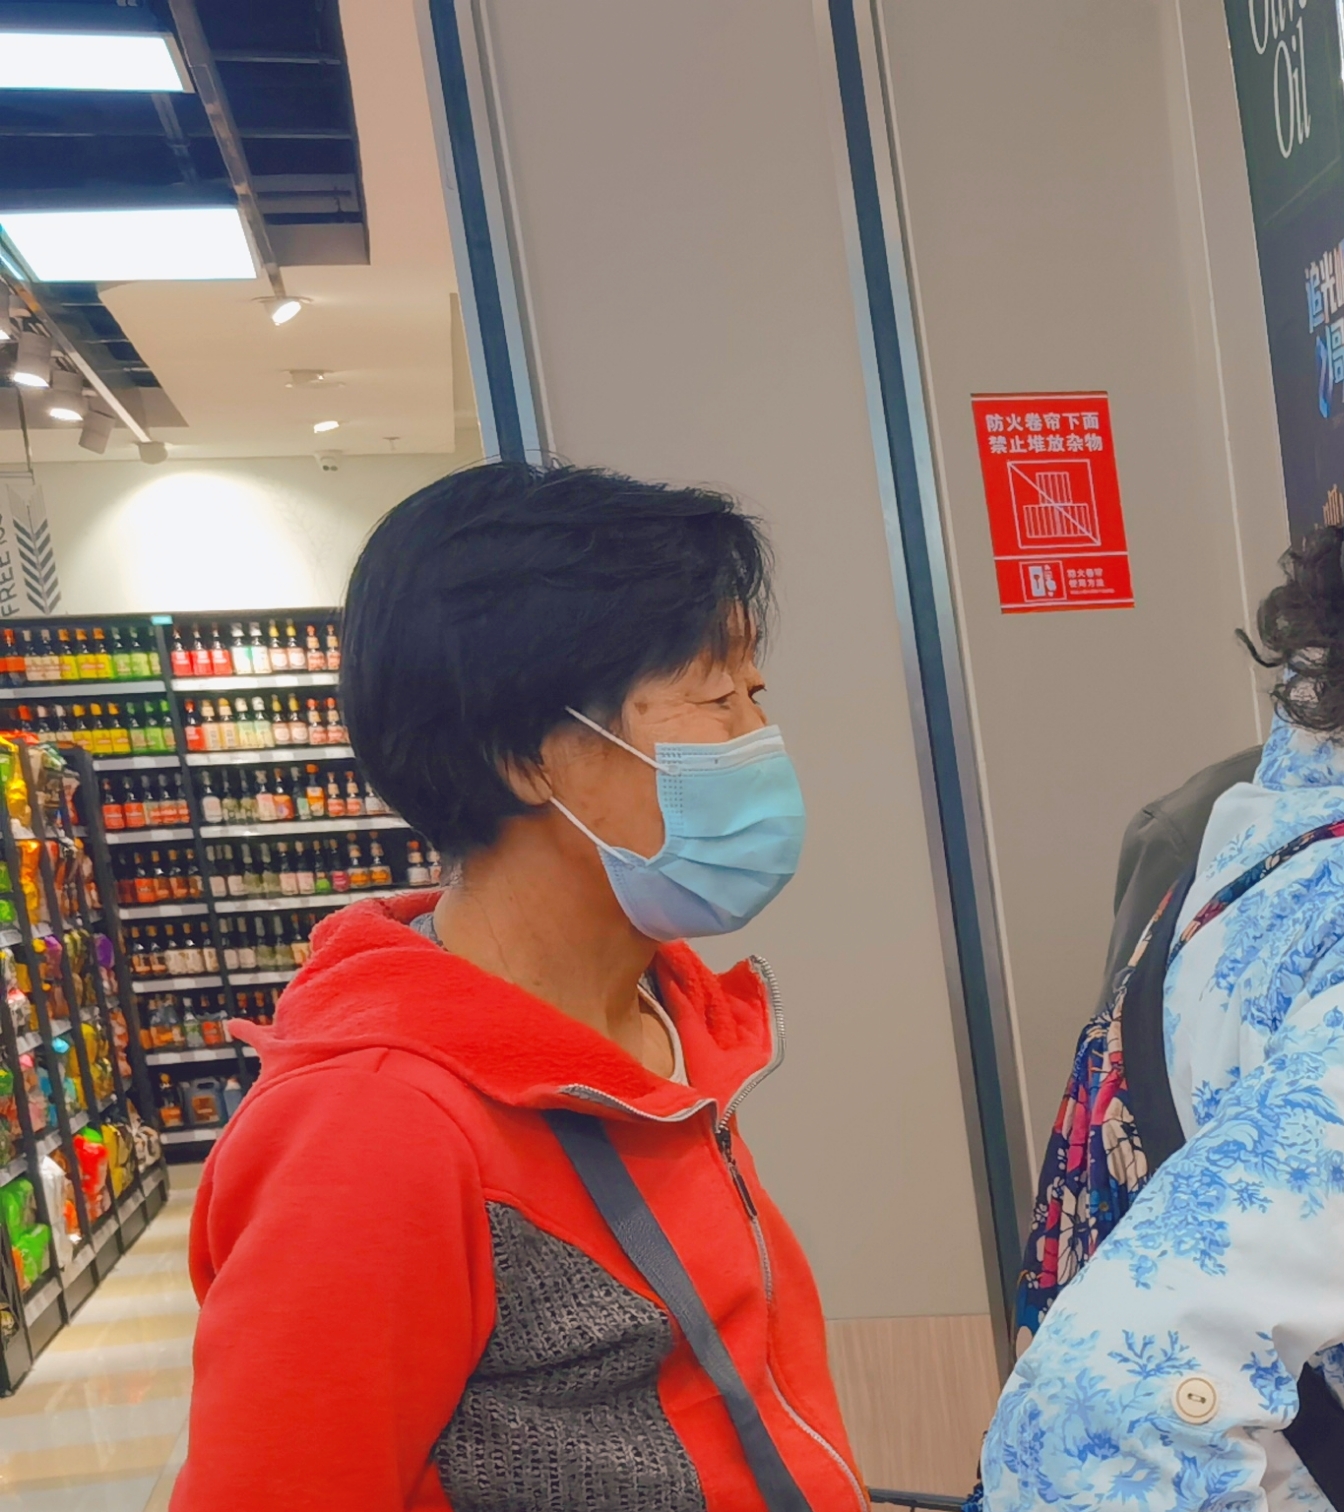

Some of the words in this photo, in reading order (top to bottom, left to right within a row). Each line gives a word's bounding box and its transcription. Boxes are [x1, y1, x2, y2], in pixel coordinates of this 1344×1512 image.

[1274, 16, 1311, 158] Oil
[985, 412, 1100, 433] 防火卷帘下面
[987, 433, 1104, 455] 禁止堆放杂物
